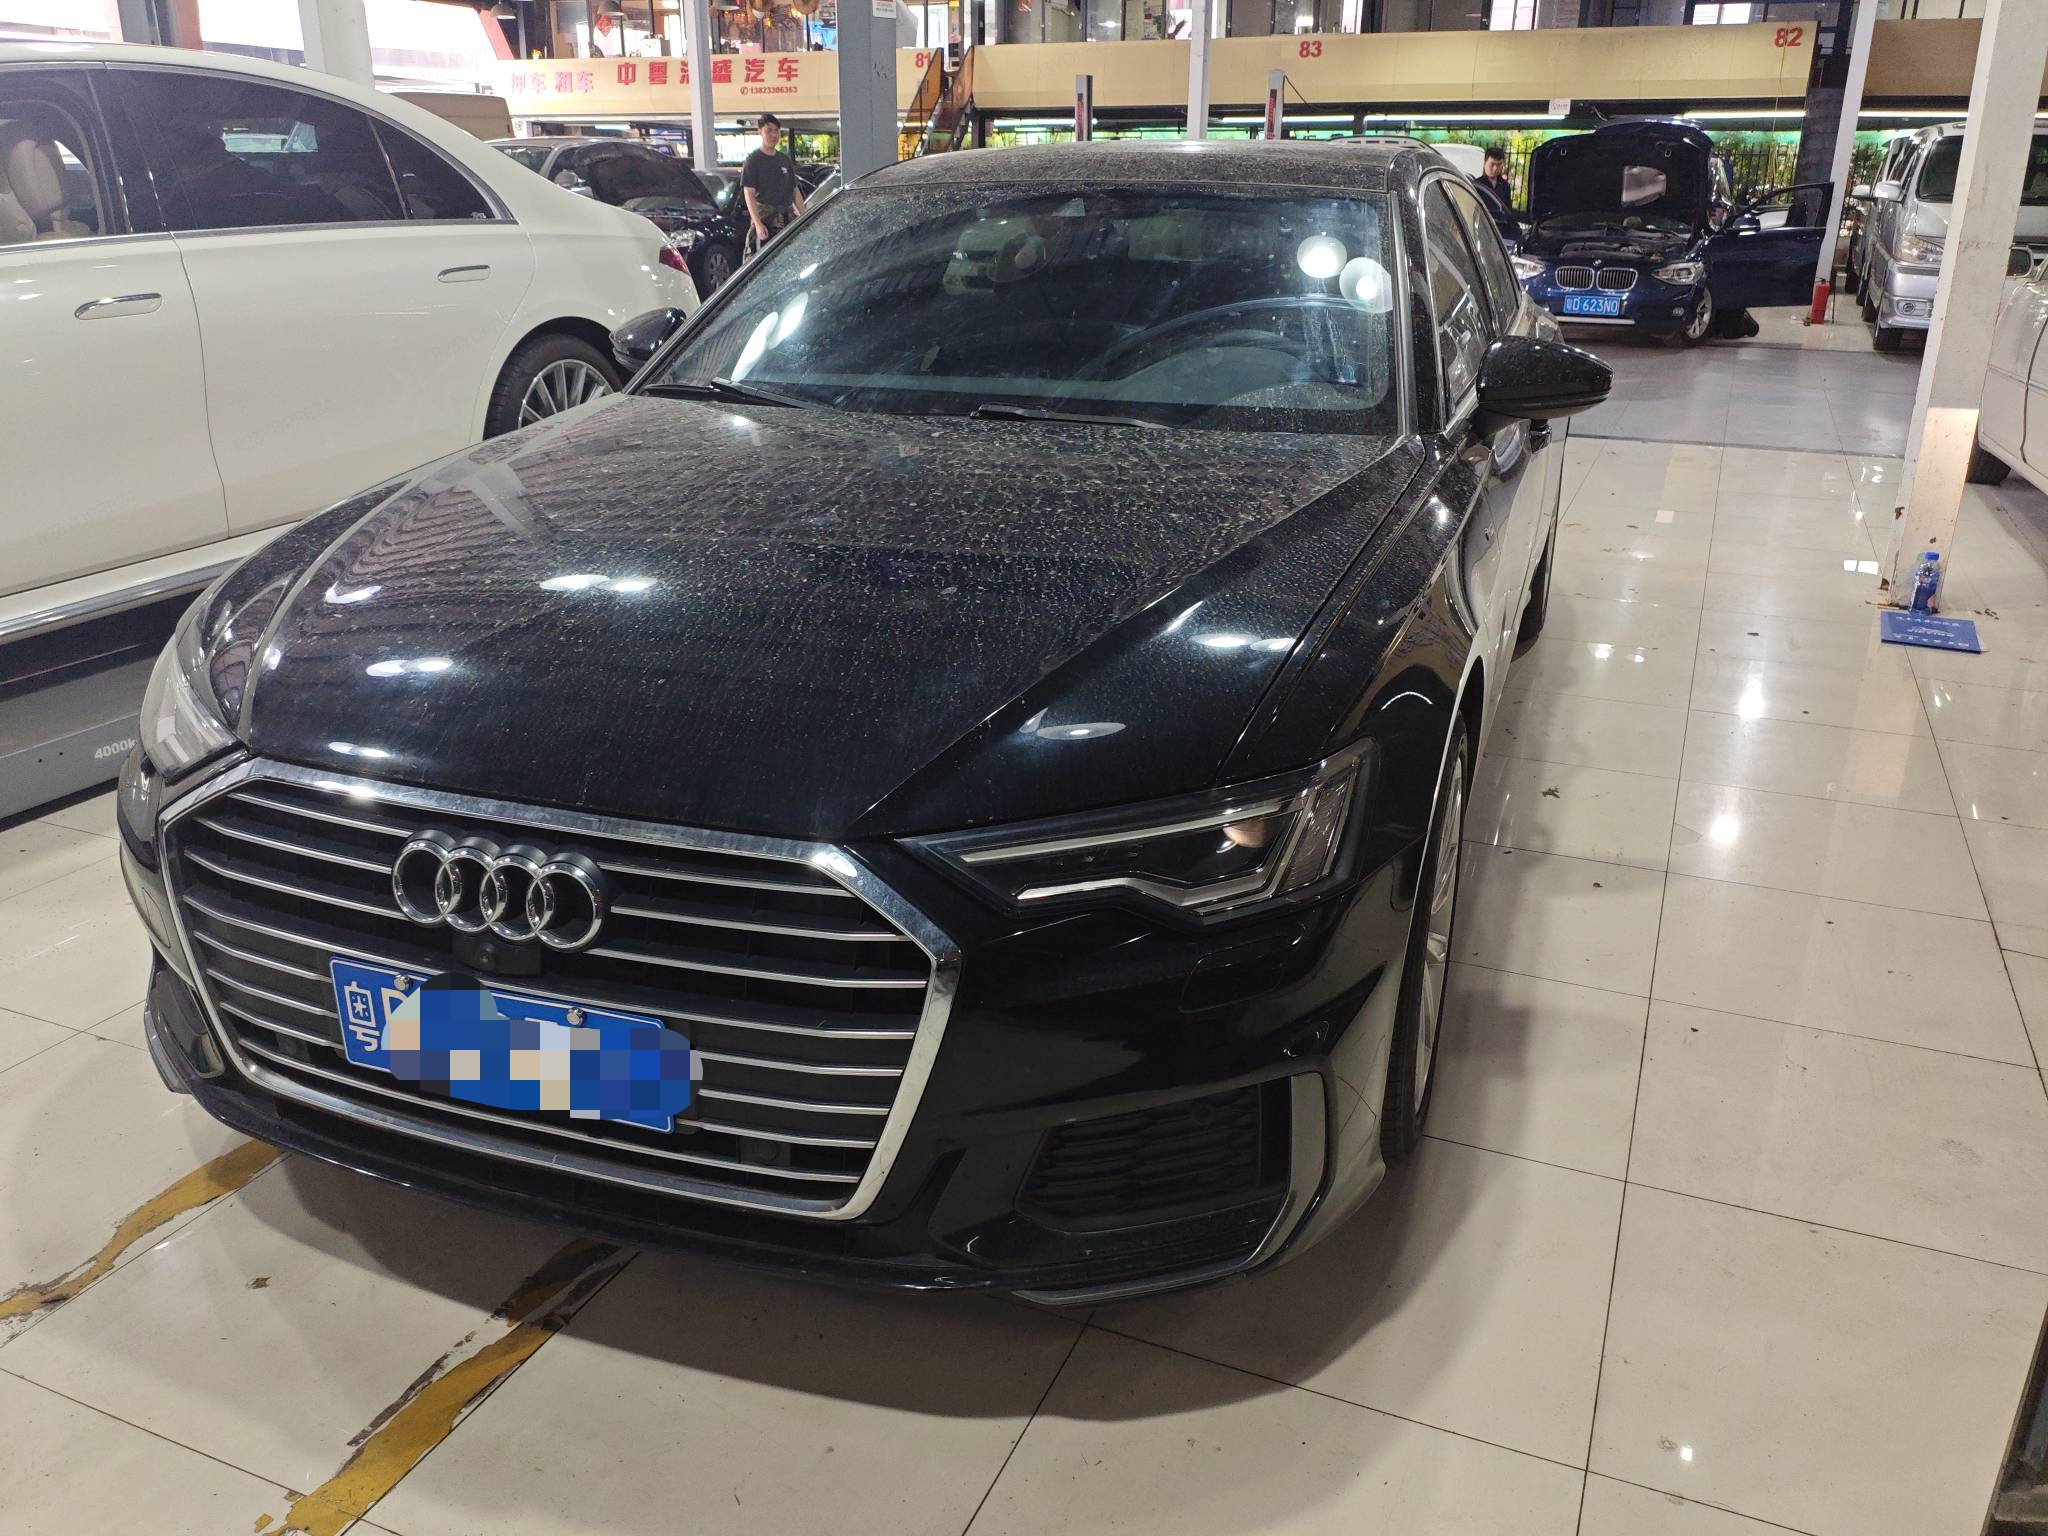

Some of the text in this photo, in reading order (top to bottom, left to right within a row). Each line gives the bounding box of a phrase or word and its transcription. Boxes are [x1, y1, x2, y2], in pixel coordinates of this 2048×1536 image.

[1774, 26, 1804, 48] 82
[1298, 40, 1323, 59] 83
[915, 51, 933, 69] 81
